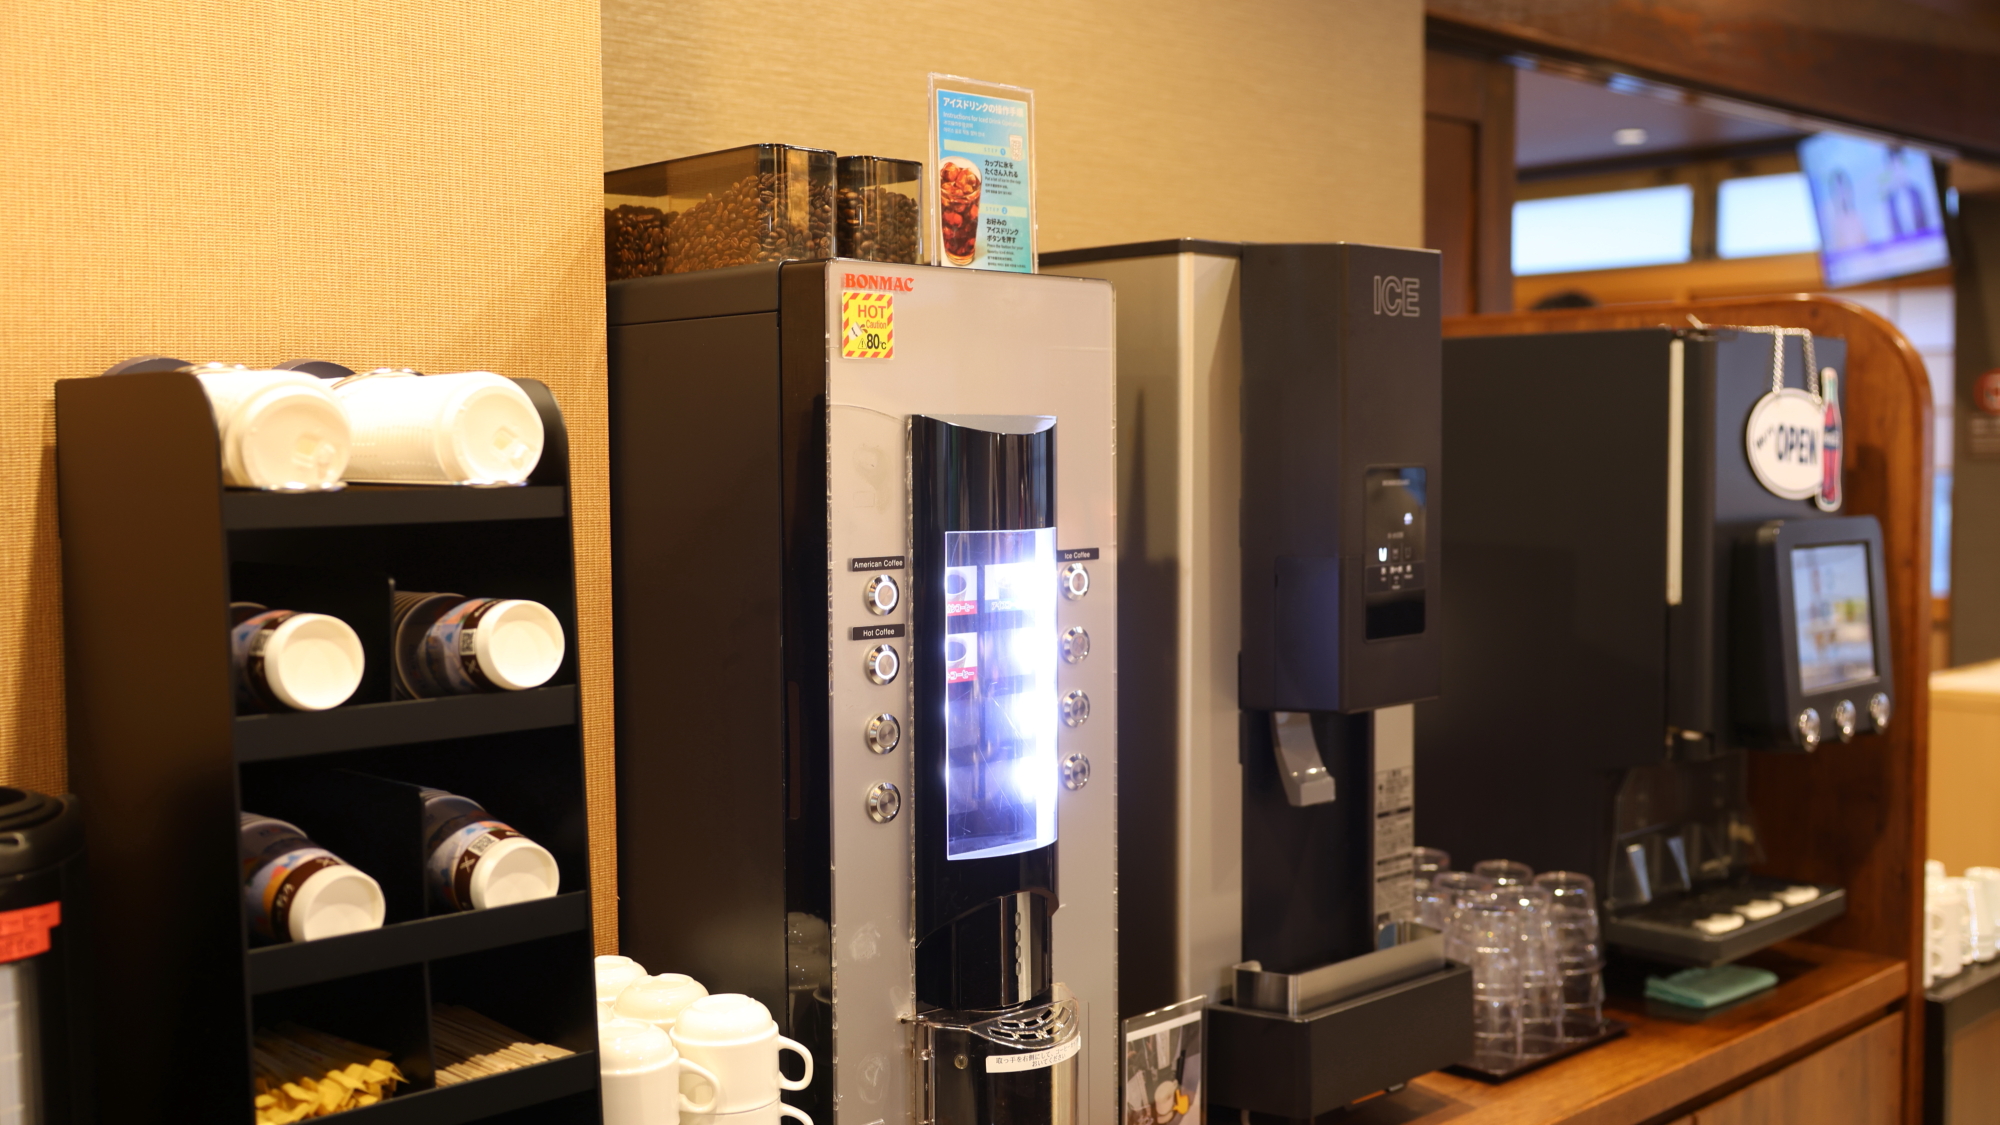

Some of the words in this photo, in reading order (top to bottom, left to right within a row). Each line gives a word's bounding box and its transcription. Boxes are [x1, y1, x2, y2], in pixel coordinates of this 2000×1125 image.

[985, 159, 1013, 169] カップに氷を
[985, 168, 1018, 178] たくさん入れる
[986, 226, 1019, 236] アイスドリンク
[844, 273, 915, 292] BONMAC
[1373, 275, 1421, 317] ICE
[858, 304, 887, 319] HOT
[866, 319, 887, 329] Caution
[1776, 424, 1818, 465] OPEN
[1073, 551, 1091, 559] Coffee
[854, 560, 882, 569] American
[883, 558, 903, 567] Coffee
[875, 628, 895, 636] Coffee
[1032, 1054, 1066, 1067] おいてください
